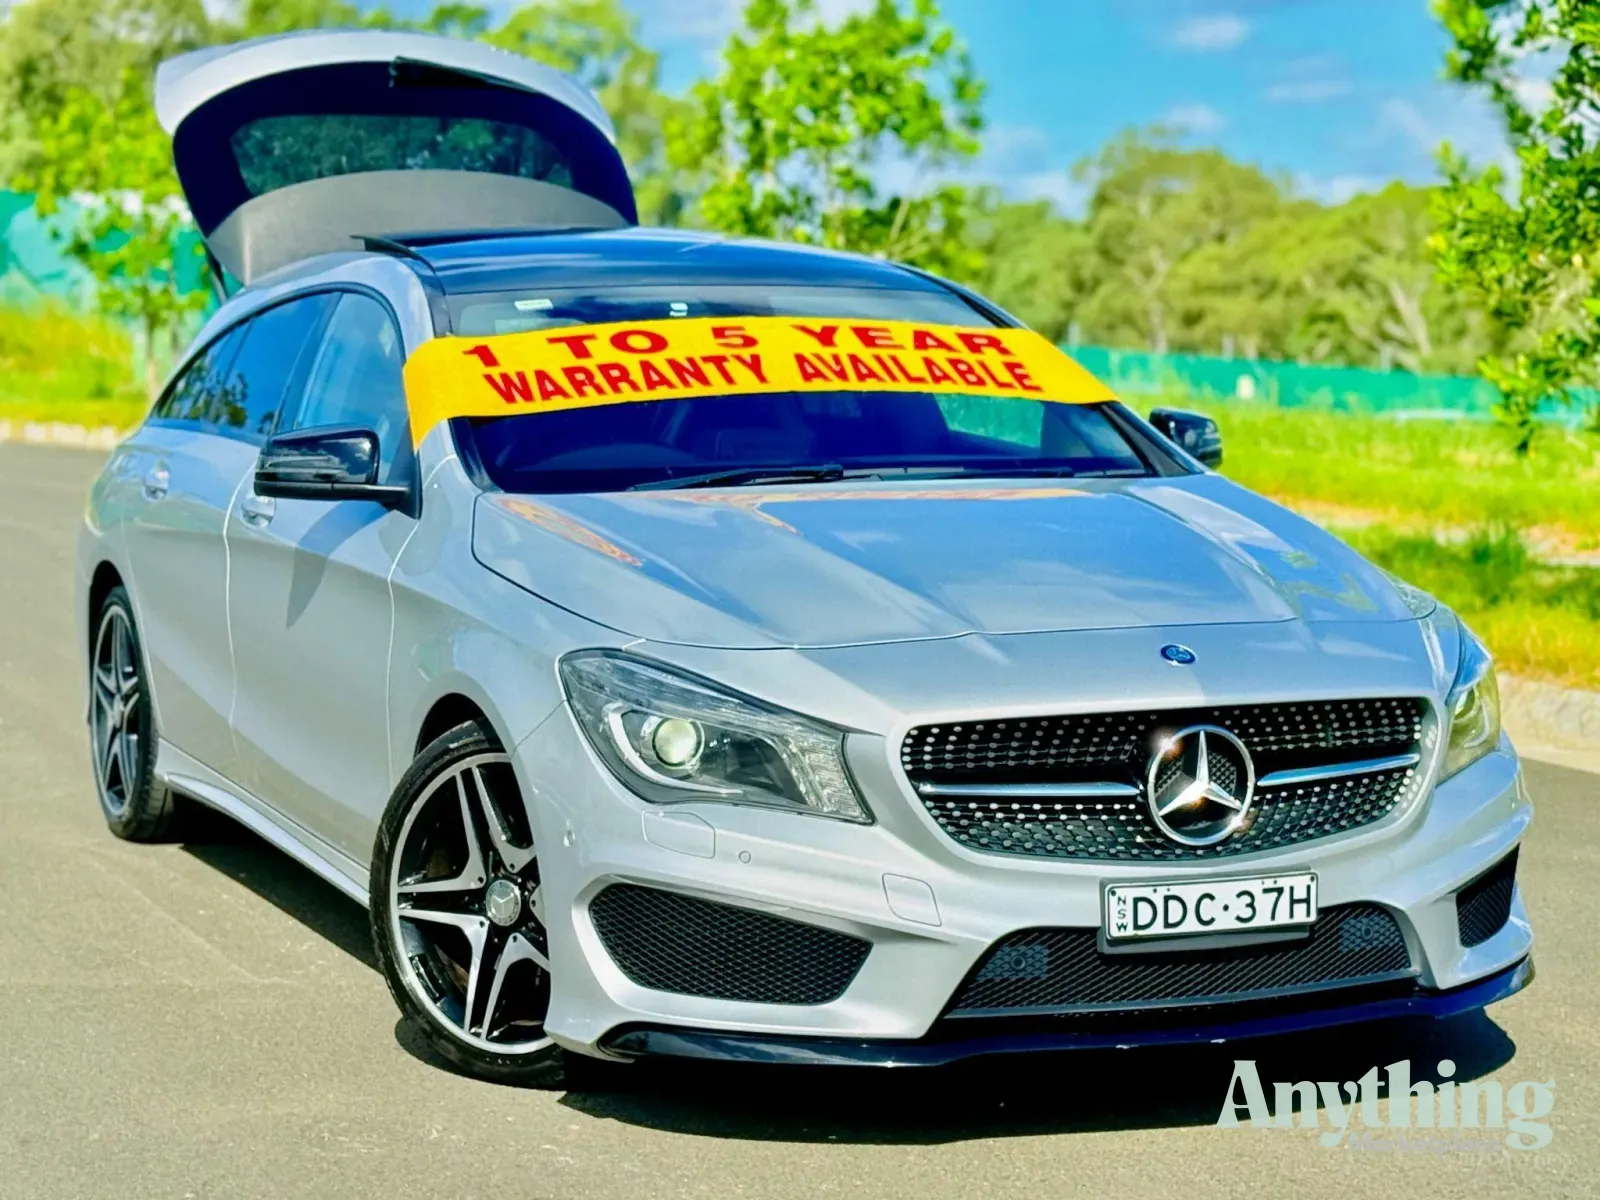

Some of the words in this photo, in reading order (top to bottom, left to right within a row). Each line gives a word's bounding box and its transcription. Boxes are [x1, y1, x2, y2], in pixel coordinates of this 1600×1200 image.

[462, 344, 500, 368] 1
[545, 329, 669, 360] TO
[711, 326, 760, 350] 5
[791, 325, 1015, 356] YEAR
[482, 353, 770, 405] WARRANTY
[793, 353, 1044, 392] AVAILABLE
